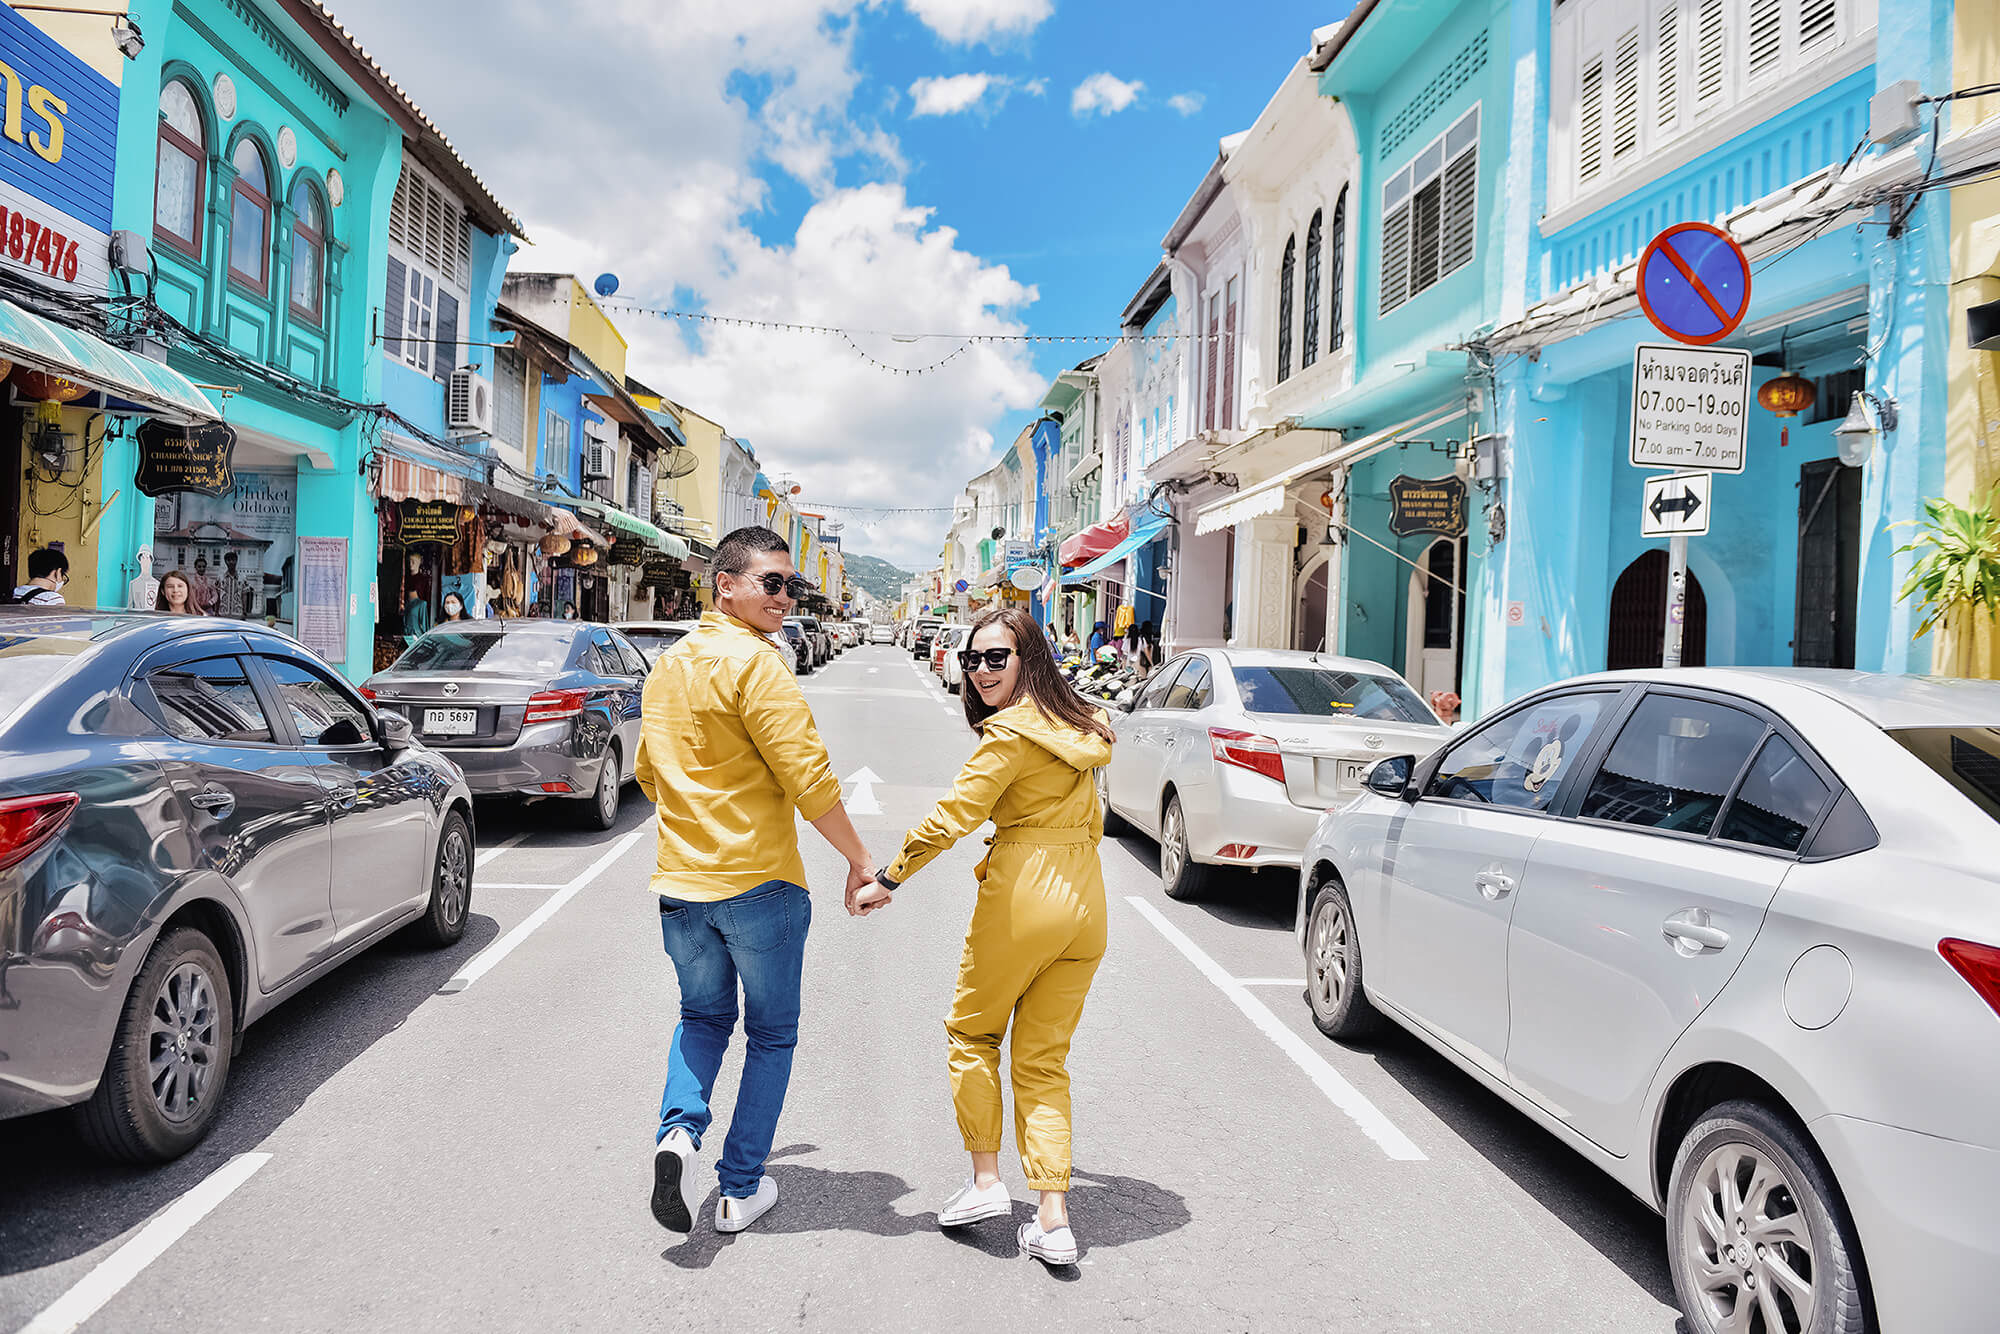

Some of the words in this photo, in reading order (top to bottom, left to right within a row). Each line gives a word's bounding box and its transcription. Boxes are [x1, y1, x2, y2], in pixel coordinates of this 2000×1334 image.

[1642, 357, 1744, 386] ห้ามจอดวันคี่
[1639, 420, 1652, 431] No
[1655, 420, 1690, 435] Parking
[1694, 422, 1712, 433] Odd
[1716, 424, 1737, 437] Days
[192, 453, 212, 461] SHOP
[1639, 438, 1662, 454] 7.00
[1721, 451, 1738, 460] pm
[234, 485, 288, 501] Phuket
[233, 500, 290, 514] Oldtown
[450, 711, 474, 722] 5697
